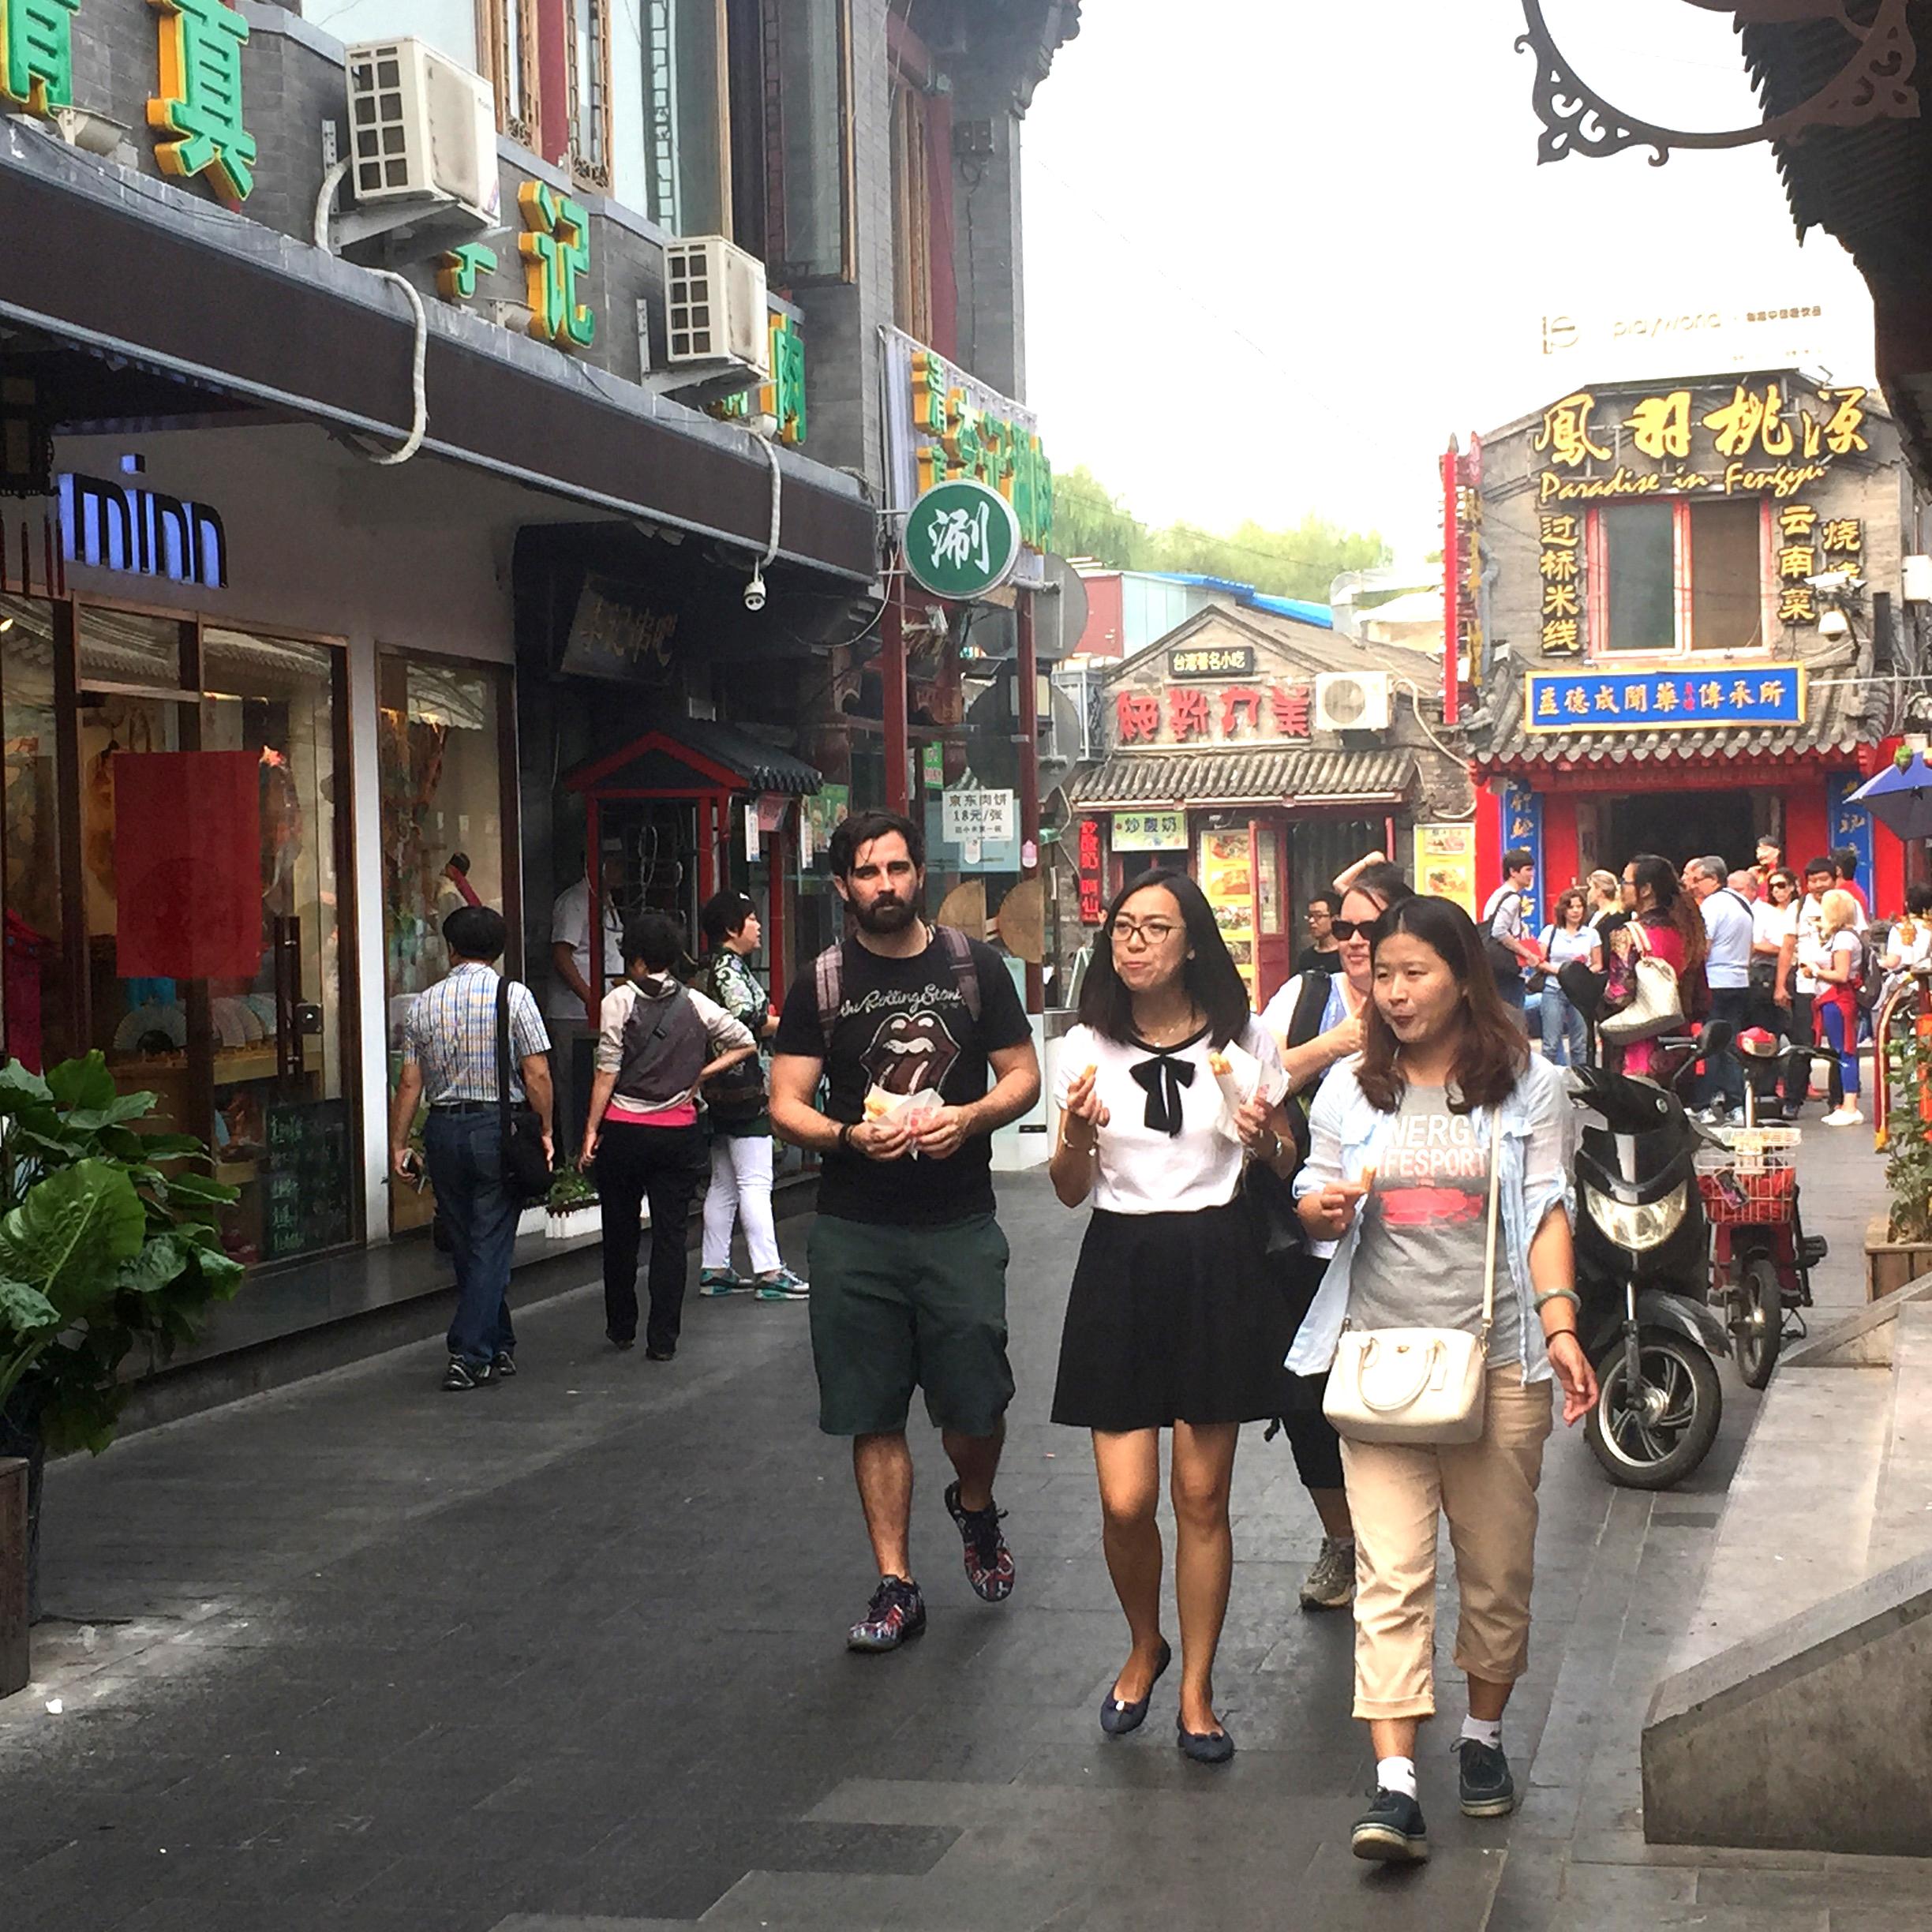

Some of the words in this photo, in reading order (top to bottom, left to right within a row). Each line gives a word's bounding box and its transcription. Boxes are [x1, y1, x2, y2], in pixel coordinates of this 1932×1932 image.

[1540, 470, 1661, 503] Paradise
[1672, 466, 1709, 489] in
[1724, 462, 1829, 498] Fengyu
[927, 500, 990, 575] 涮
[1778, 504, 1816, 620] 云南菜
[1540, 515, 1580, 650] 过桥米线
[1124, 816, 1178, 834] 炒酸奶
